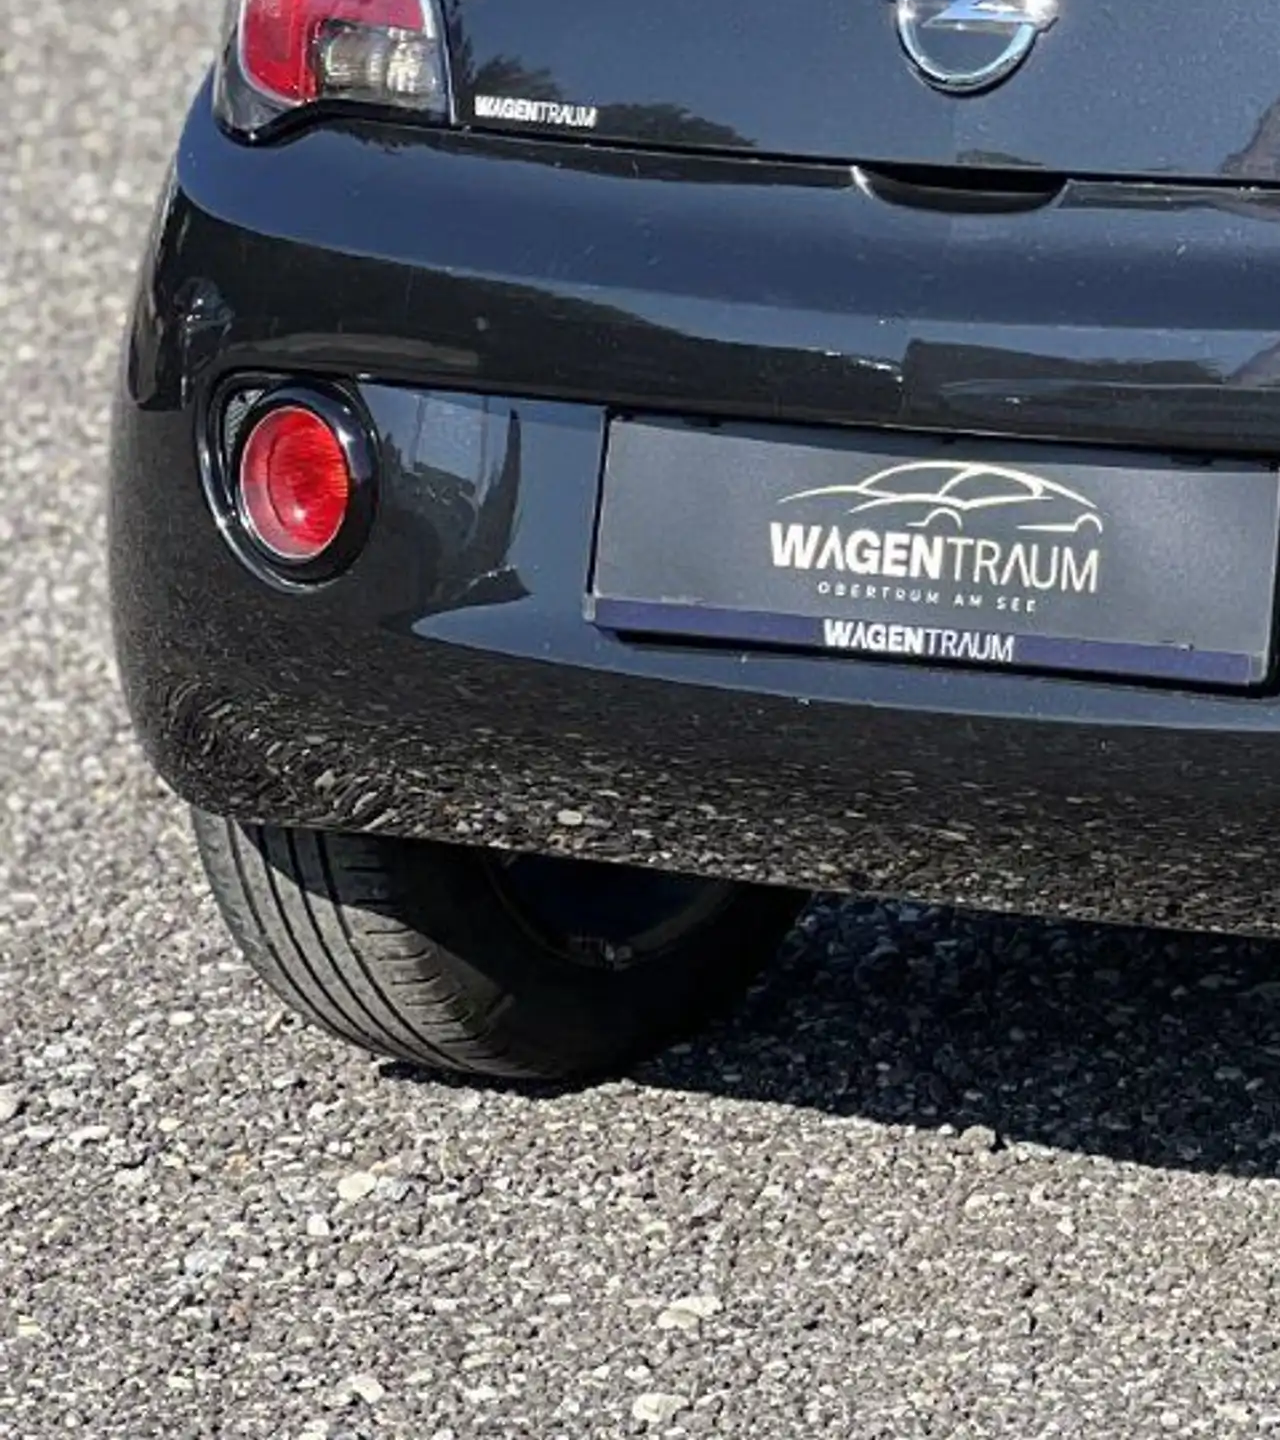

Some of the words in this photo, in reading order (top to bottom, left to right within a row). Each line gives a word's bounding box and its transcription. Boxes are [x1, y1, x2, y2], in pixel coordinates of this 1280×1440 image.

[474, 95, 598, 128] WAGENTRAUM
[769, 522, 1099, 594] WAGENTRAUM
[818, 581, 940, 605] OBERTRUM
[954, 594, 982, 608] AM
[997, 596, 1037, 613] SEE
[823, 618, 1015, 663] WAGENTRAUM
